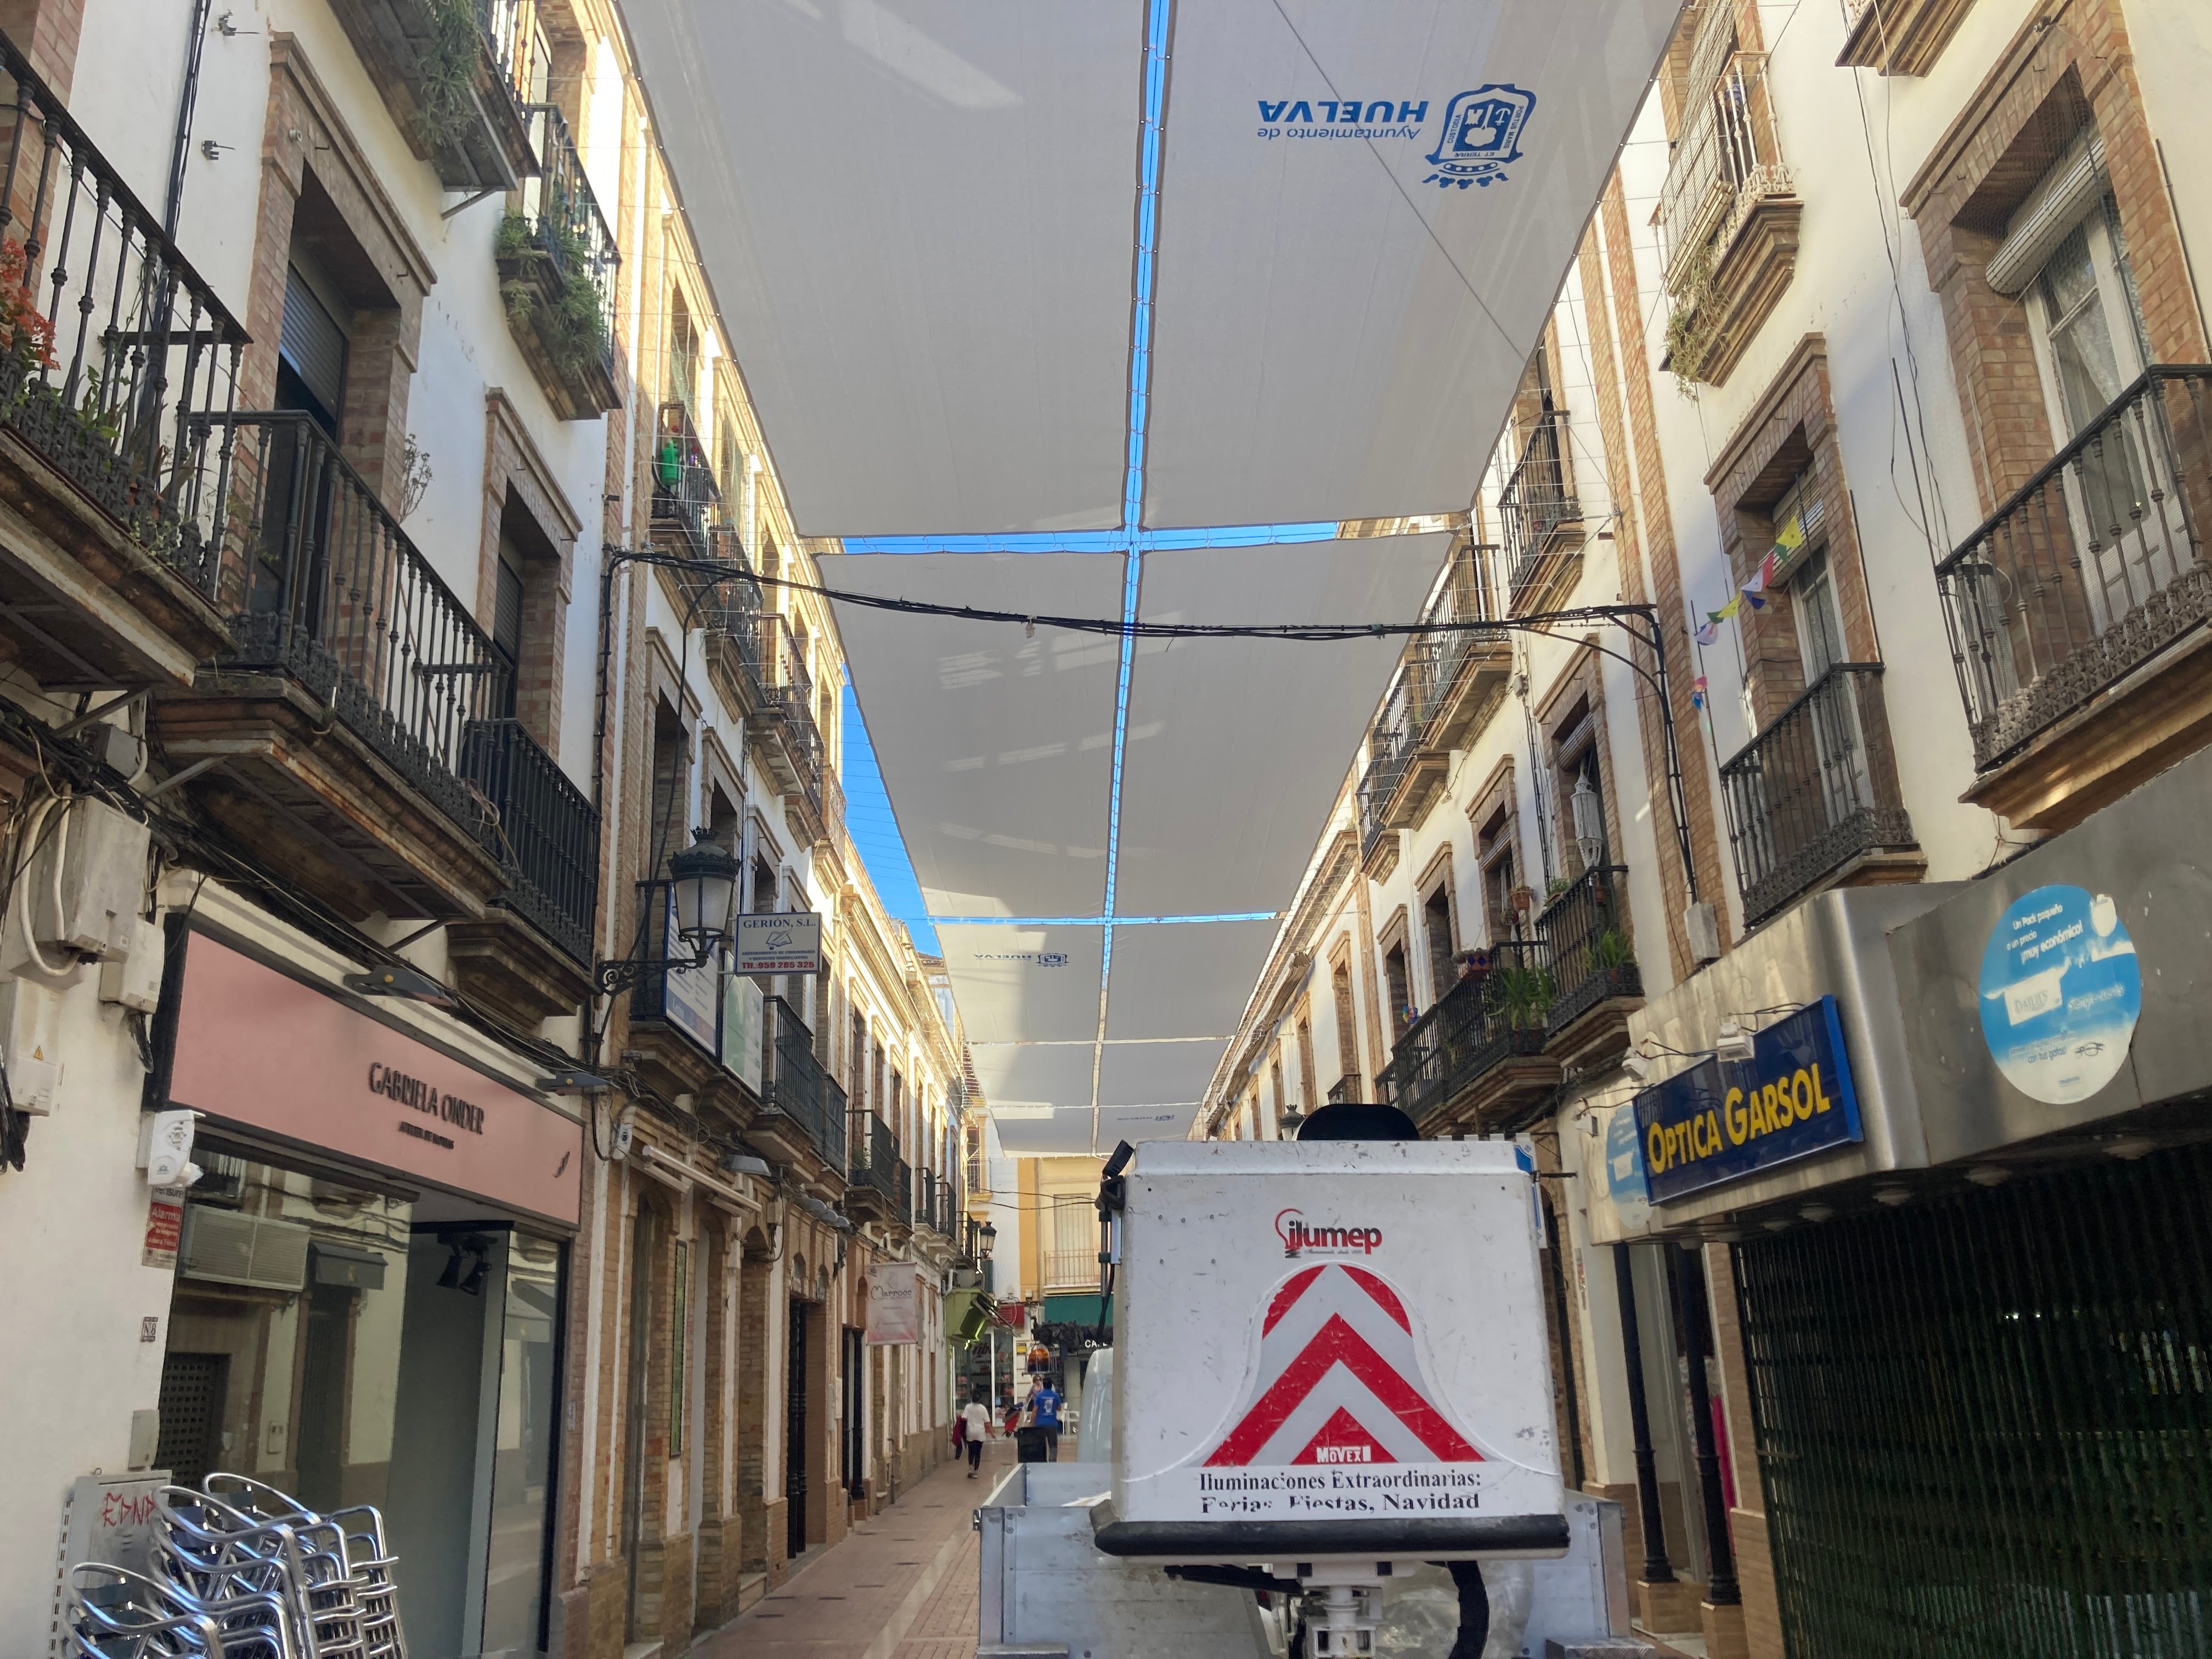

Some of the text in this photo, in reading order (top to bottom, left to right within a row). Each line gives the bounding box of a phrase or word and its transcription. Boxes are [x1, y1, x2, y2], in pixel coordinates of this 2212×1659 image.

[1257, 100, 1429, 123] HUELVA
[1257, 125, 1421, 140] Ayuntamiento de
[1447, 114, 1462, 144] CUSTODIA
[1503, 105, 1524, 149] PORTUS MARIS
[796, 918, 816, 927] S.L.
[2012, 921, 2022, 930] Un
[369, 1062, 485, 1135] GABRIELA ONDER
[1648, 1062, 1831, 1174] OPTICA GARSOL
[151, 1206, 180, 1222] Alarma
[1289, 1220, 1383, 1255] ilumep
[1199, 1469, 1481, 1491] Iluminaciones Extraordinarias:
[1382, 1493, 1480, 1511] Navidad
